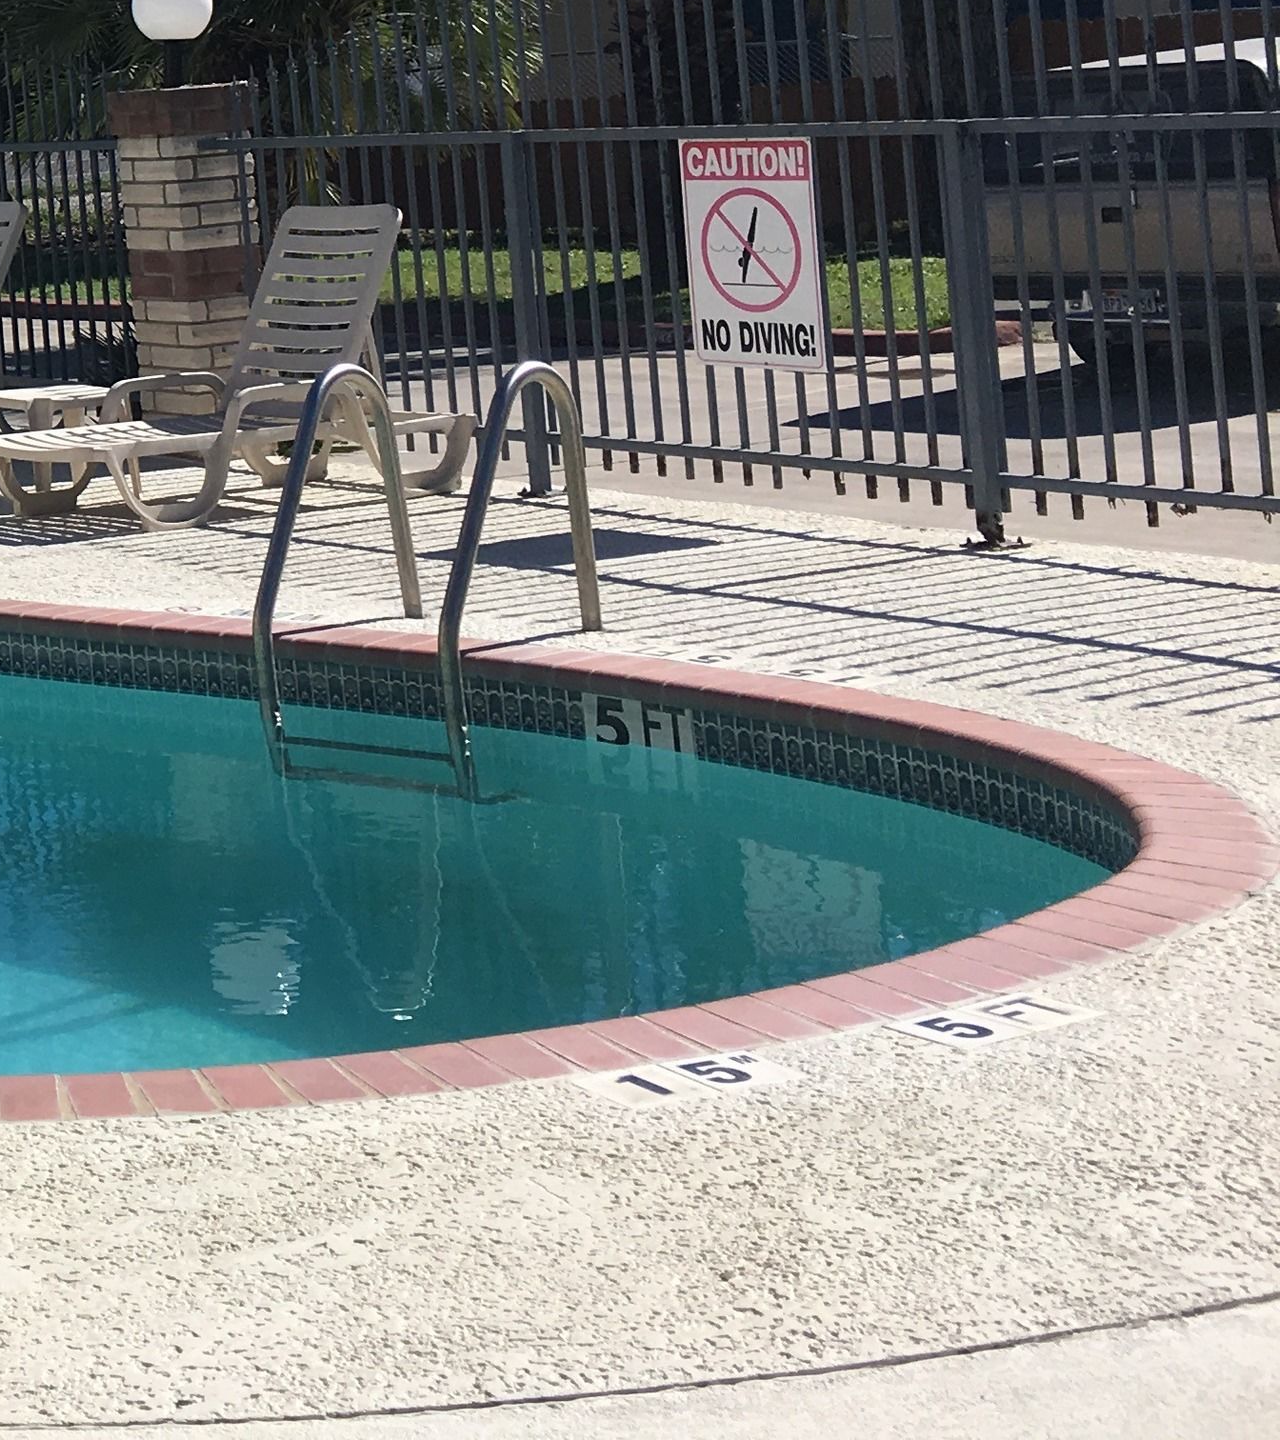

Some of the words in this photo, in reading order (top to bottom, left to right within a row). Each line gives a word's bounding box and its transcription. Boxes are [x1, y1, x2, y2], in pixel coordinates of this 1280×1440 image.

[686, 146, 804, 177] CAUTION!
[701, 318, 731, 352] NO
[739, 320, 817, 357] DIVING!
[596, 696, 630, 745] 5
[642, 701, 686, 752] FT
[917, 1016, 993, 1039] 5
[985, 996, 1072, 1025] FT
